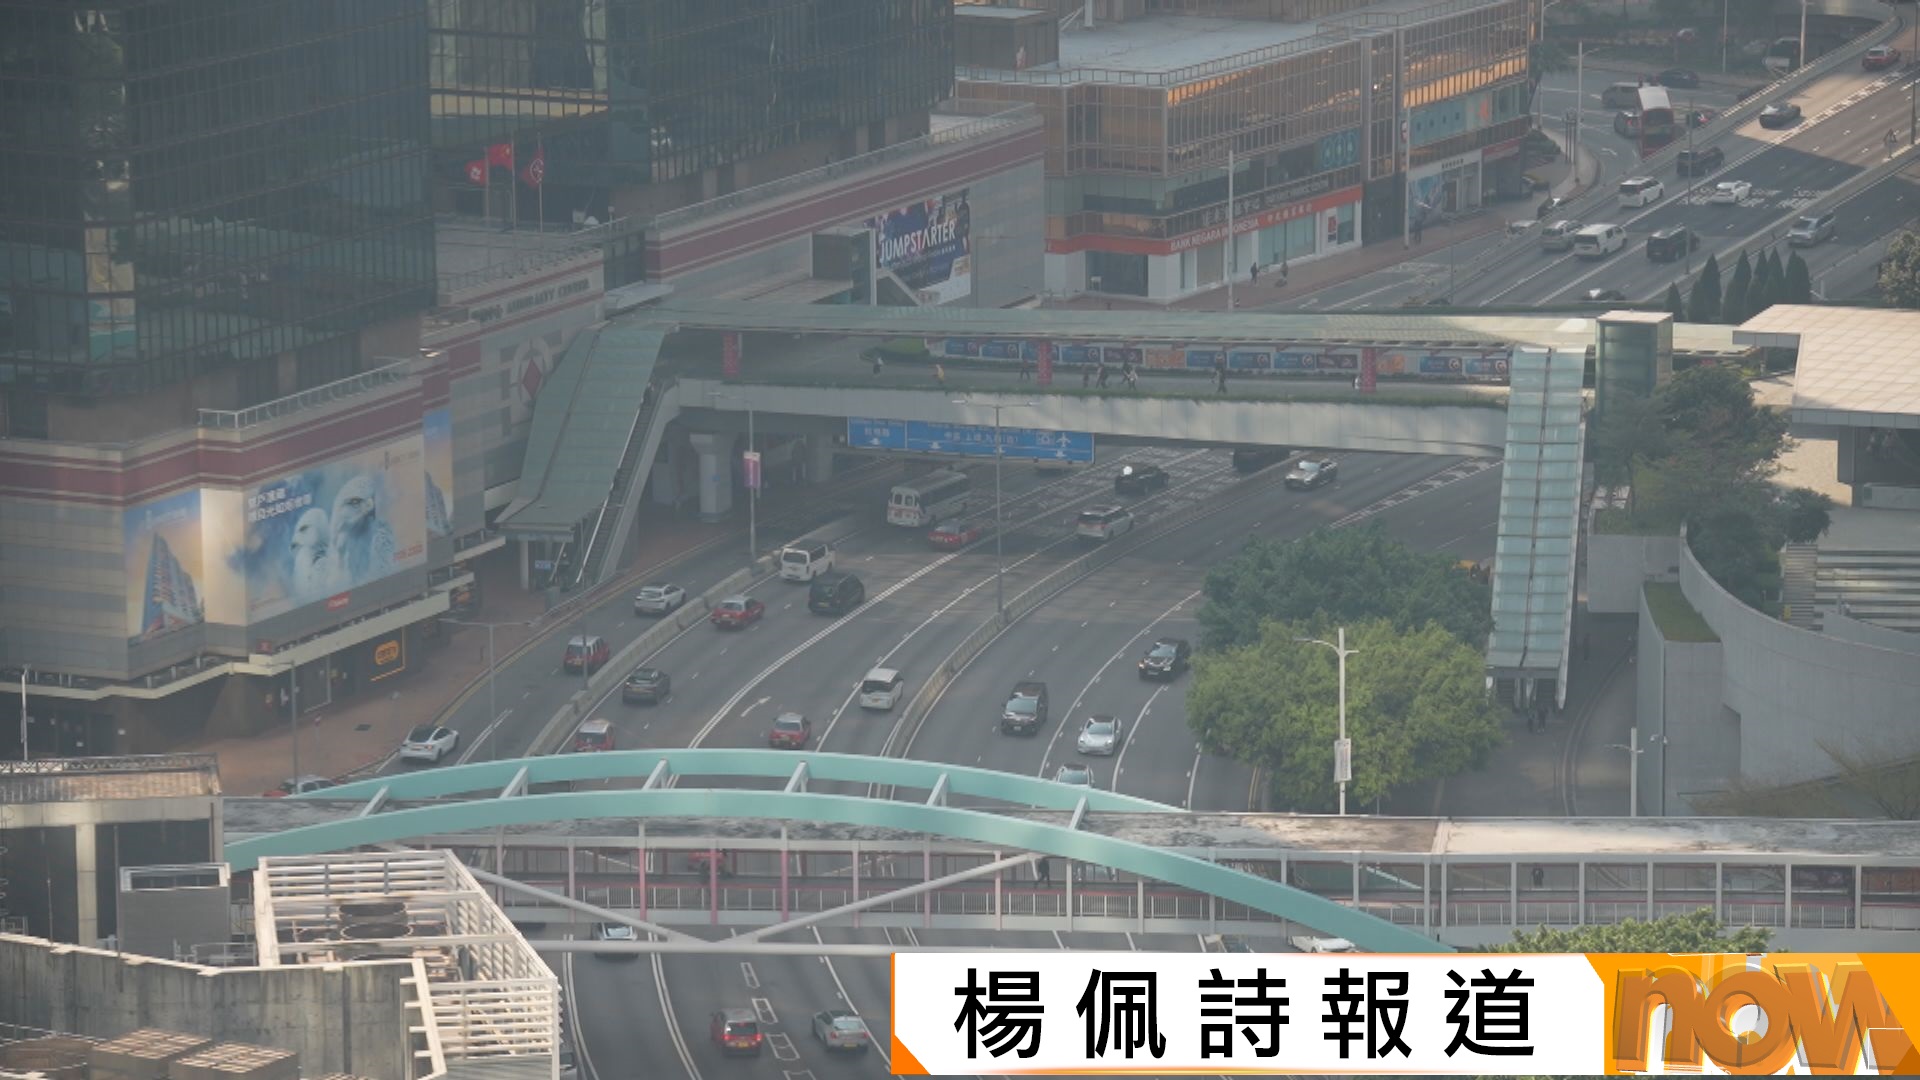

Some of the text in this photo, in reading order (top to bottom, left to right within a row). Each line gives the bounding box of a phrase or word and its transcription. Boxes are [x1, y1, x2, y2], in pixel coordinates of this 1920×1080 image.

[879, 220, 956, 264] JUMPSTARTER
[1170, 218, 1259, 252] BANK NEGARA INONESIA
